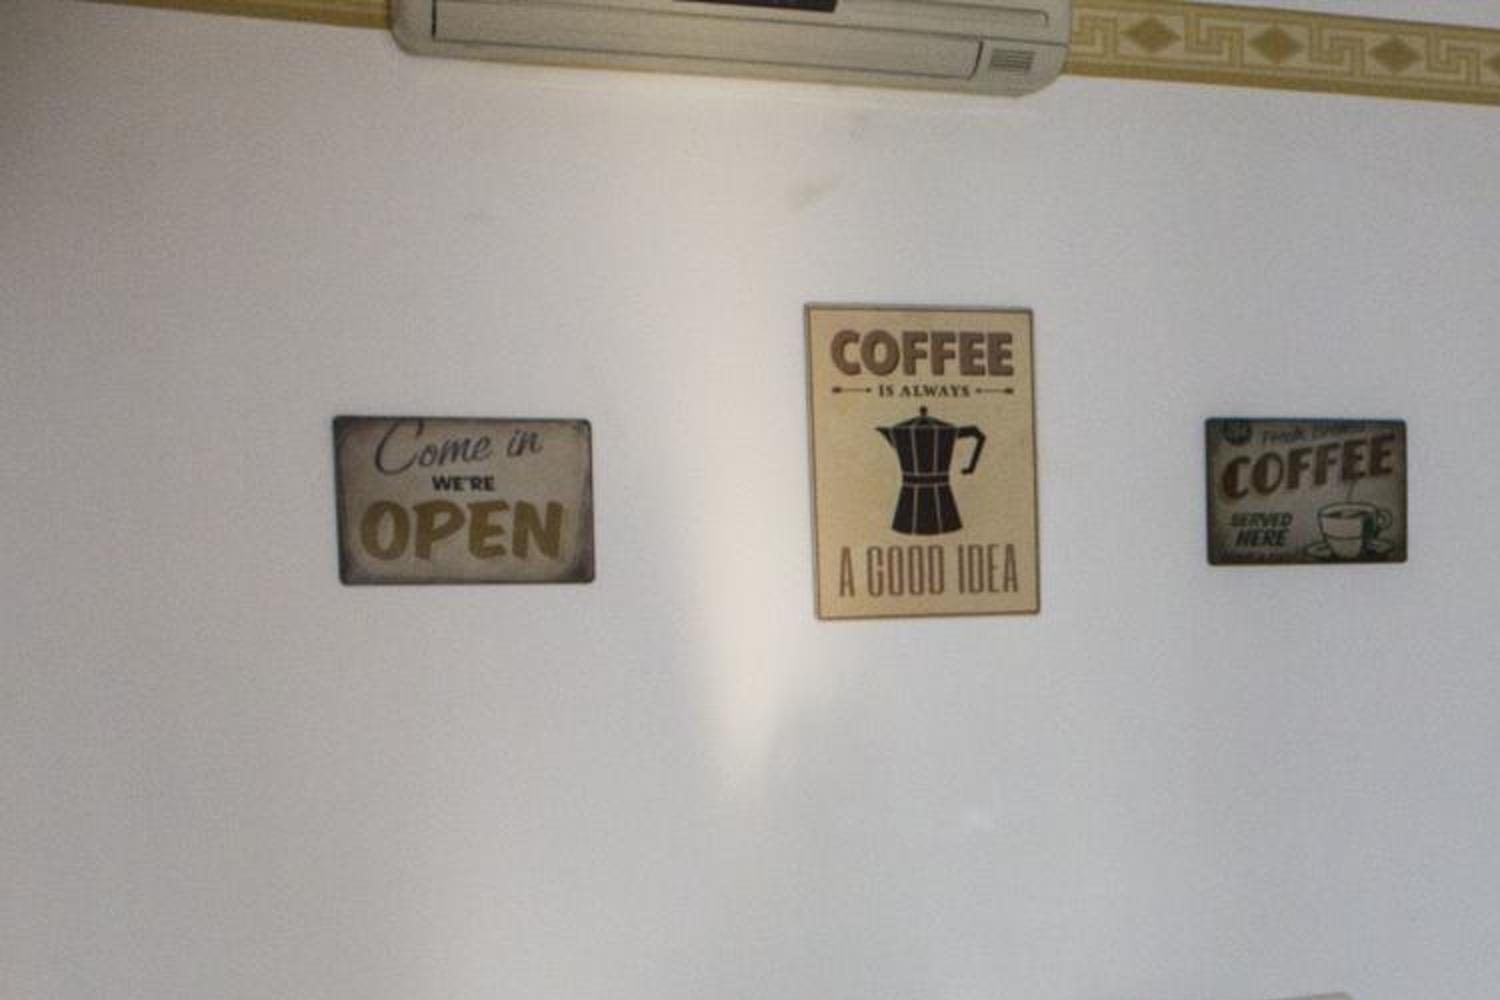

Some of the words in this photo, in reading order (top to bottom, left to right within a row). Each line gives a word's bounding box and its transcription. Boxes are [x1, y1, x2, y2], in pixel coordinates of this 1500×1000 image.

[831, 330, 1015, 377] COFFEE
[878, 384, 894, 398] IS
[899, 384, 971, 399] ALWAYS
[374, 420, 491, 475] Come
[506, 429, 543, 458] in
[1222, 433, 1396, 499] COFFEE
[360, 500, 564, 560] OPEN
[1235, 529, 1291, 547] HERE
[838, 546, 855, 597] A
[866, 544, 945, 597] GOOD
[958, 543, 1019, 594] IDEA
